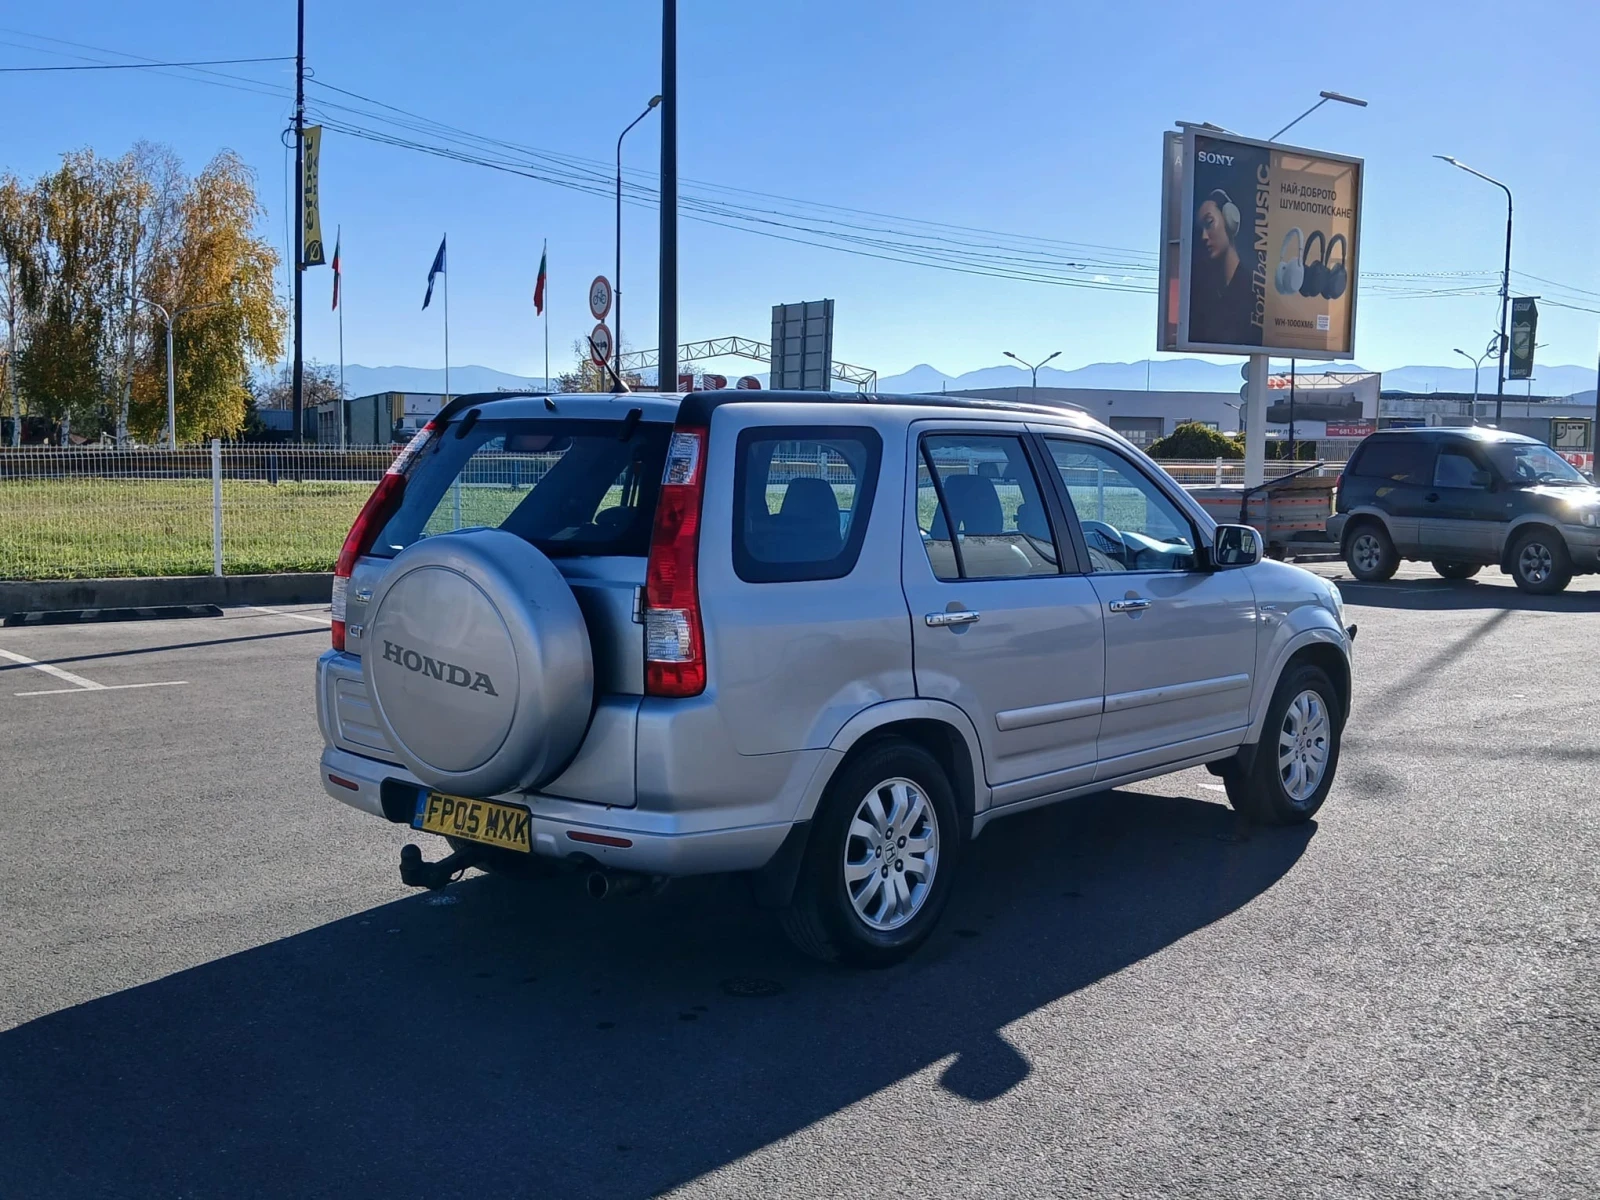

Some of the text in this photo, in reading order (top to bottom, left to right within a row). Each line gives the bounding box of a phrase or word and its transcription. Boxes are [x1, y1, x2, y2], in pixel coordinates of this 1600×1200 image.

[1198, 151, 1235, 166] SONY
[1280, 182, 1337, 201] НАЙ-ДОБРОТО
[1280, 198, 1353, 219] ШУМОПОТИСКАНЕ
[1274, 317, 1314, 329] WH-1000XM6
[382, 640, 499, 697] HONDA
[426, 795, 529, 845] FP05 MXK
